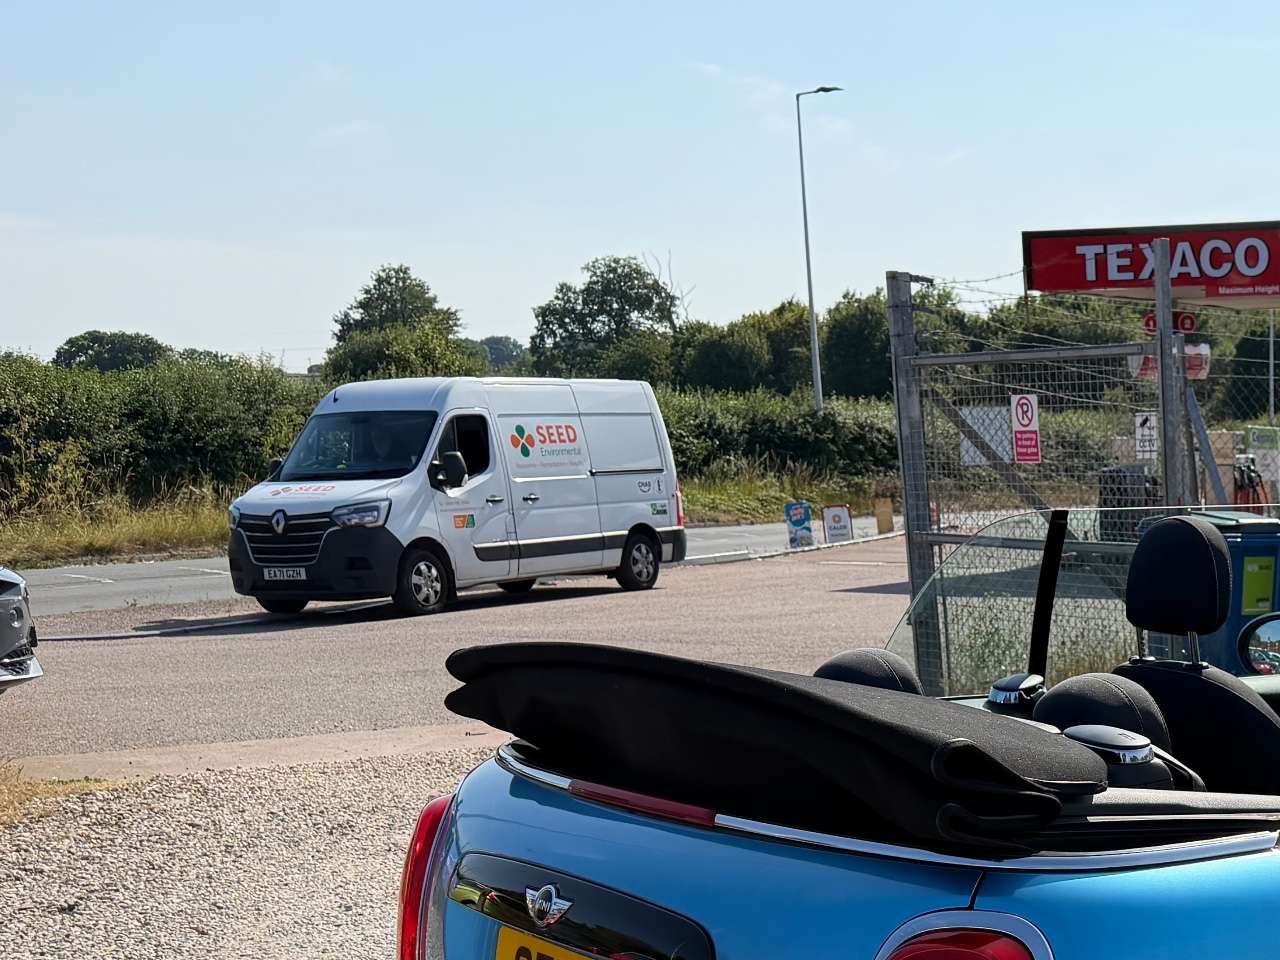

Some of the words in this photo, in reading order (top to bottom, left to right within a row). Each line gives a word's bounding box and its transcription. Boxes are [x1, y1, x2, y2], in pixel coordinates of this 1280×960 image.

[1075, 237, 1270, 282] TEXACO
[1254, 284, 1280, 295] Height
[535, 424, 577, 445] SEED
